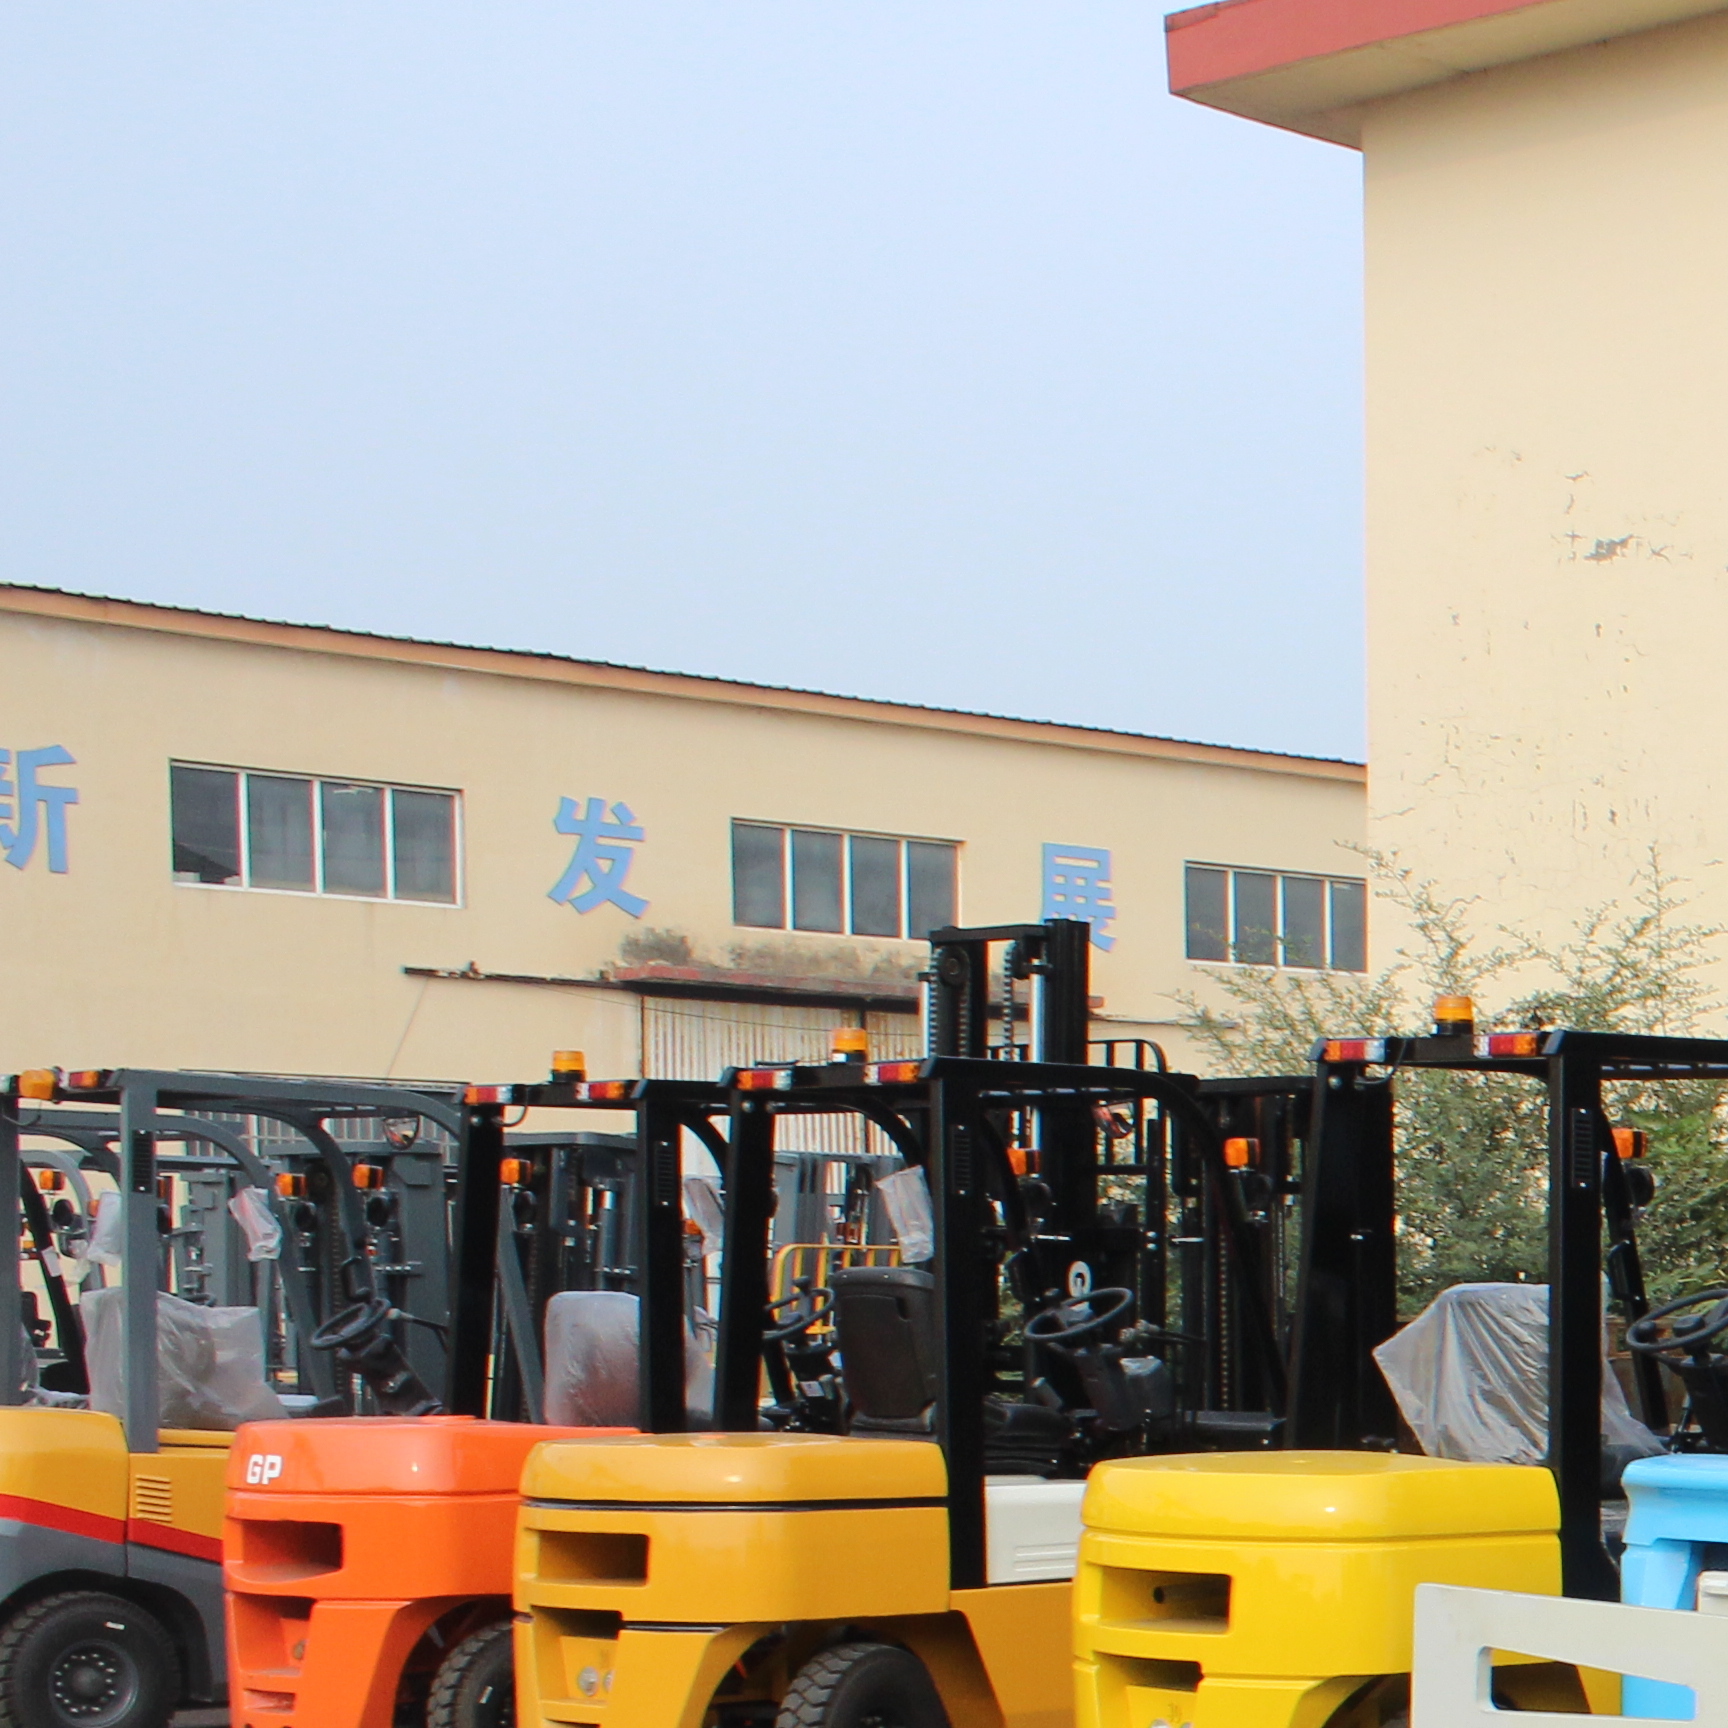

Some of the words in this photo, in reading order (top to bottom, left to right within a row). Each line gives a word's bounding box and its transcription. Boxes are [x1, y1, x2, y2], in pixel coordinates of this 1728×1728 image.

[547, 795, 650, 919] 发
[1042, 842, 1117, 953] 展
[246, 1454, 283, 1485] GP
